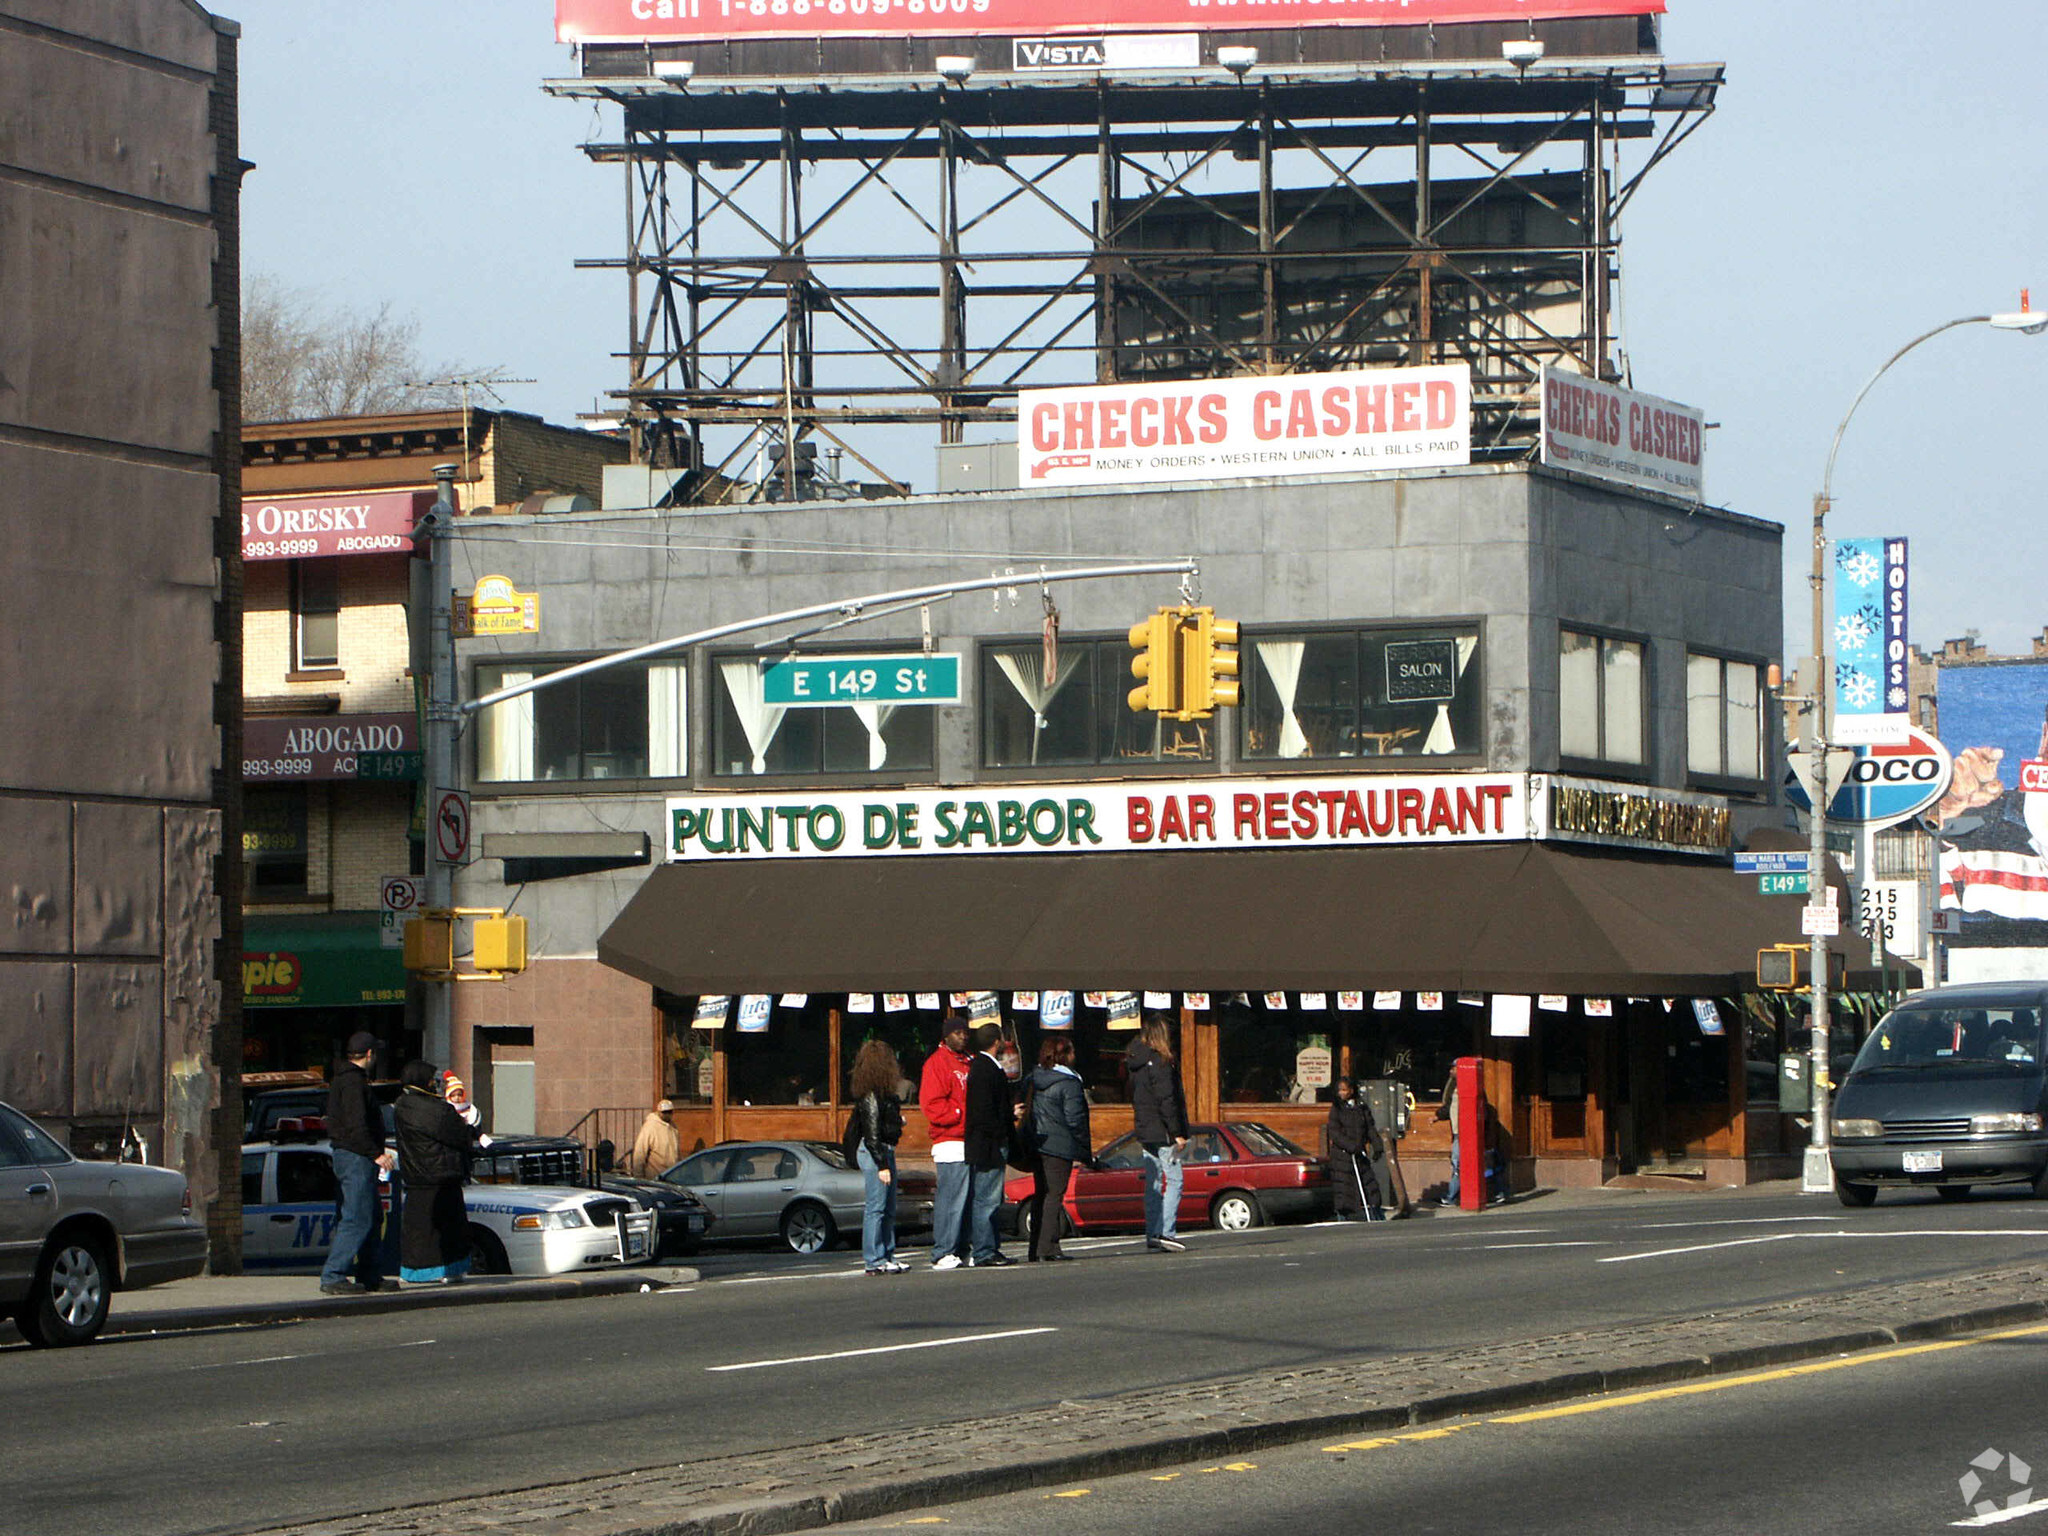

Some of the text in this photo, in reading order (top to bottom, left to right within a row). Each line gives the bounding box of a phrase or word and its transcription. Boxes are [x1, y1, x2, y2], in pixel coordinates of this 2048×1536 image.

[1031, 380, 1456, 452] CHECKS CASHED
[1546, 378, 1700, 466] CHECKS CASHED
[1096, 458, 1144, 470] MONEY
[1150, 455, 1206, 468] ORDERS
[1220, 451, 1288, 464] WESTERN
[1292, 447, 1334, 461] UNION
[1352, 445, 1380, 457] ALL
[1385, 442, 1423, 455] BILLS
[1428, 440, 1459, 452] PAID
[257, 505, 370, 535] ORESKY
[337, 535, 402, 551] ABOGADO
[1888, 542, 1905, 685] HOSTOS
[794, 667, 927, 696] E 149 St
[1400, 662, 1442, 678] SALON
[283, 724, 404, 754] ABOGADO
[361, 756, 371, 776] E
[375, 755, 405, 776] 149
[1843, 758, 1940, 783] OCO
[672, 803, 845, 854] PUNTO
[863, 801, 922, 850] DE
[934, 798, 1102, 848] SABOR
[1127, 793, 1218, 843] BAR
[1233, 784, 1513, 840] RESTAURANT
[1761, 876, 1770, 892] E
[1773, 876, 1795, 891] 149
[1861, 925, 1895, 940] 23
[475, 1204, 513, 1215] POLICE
